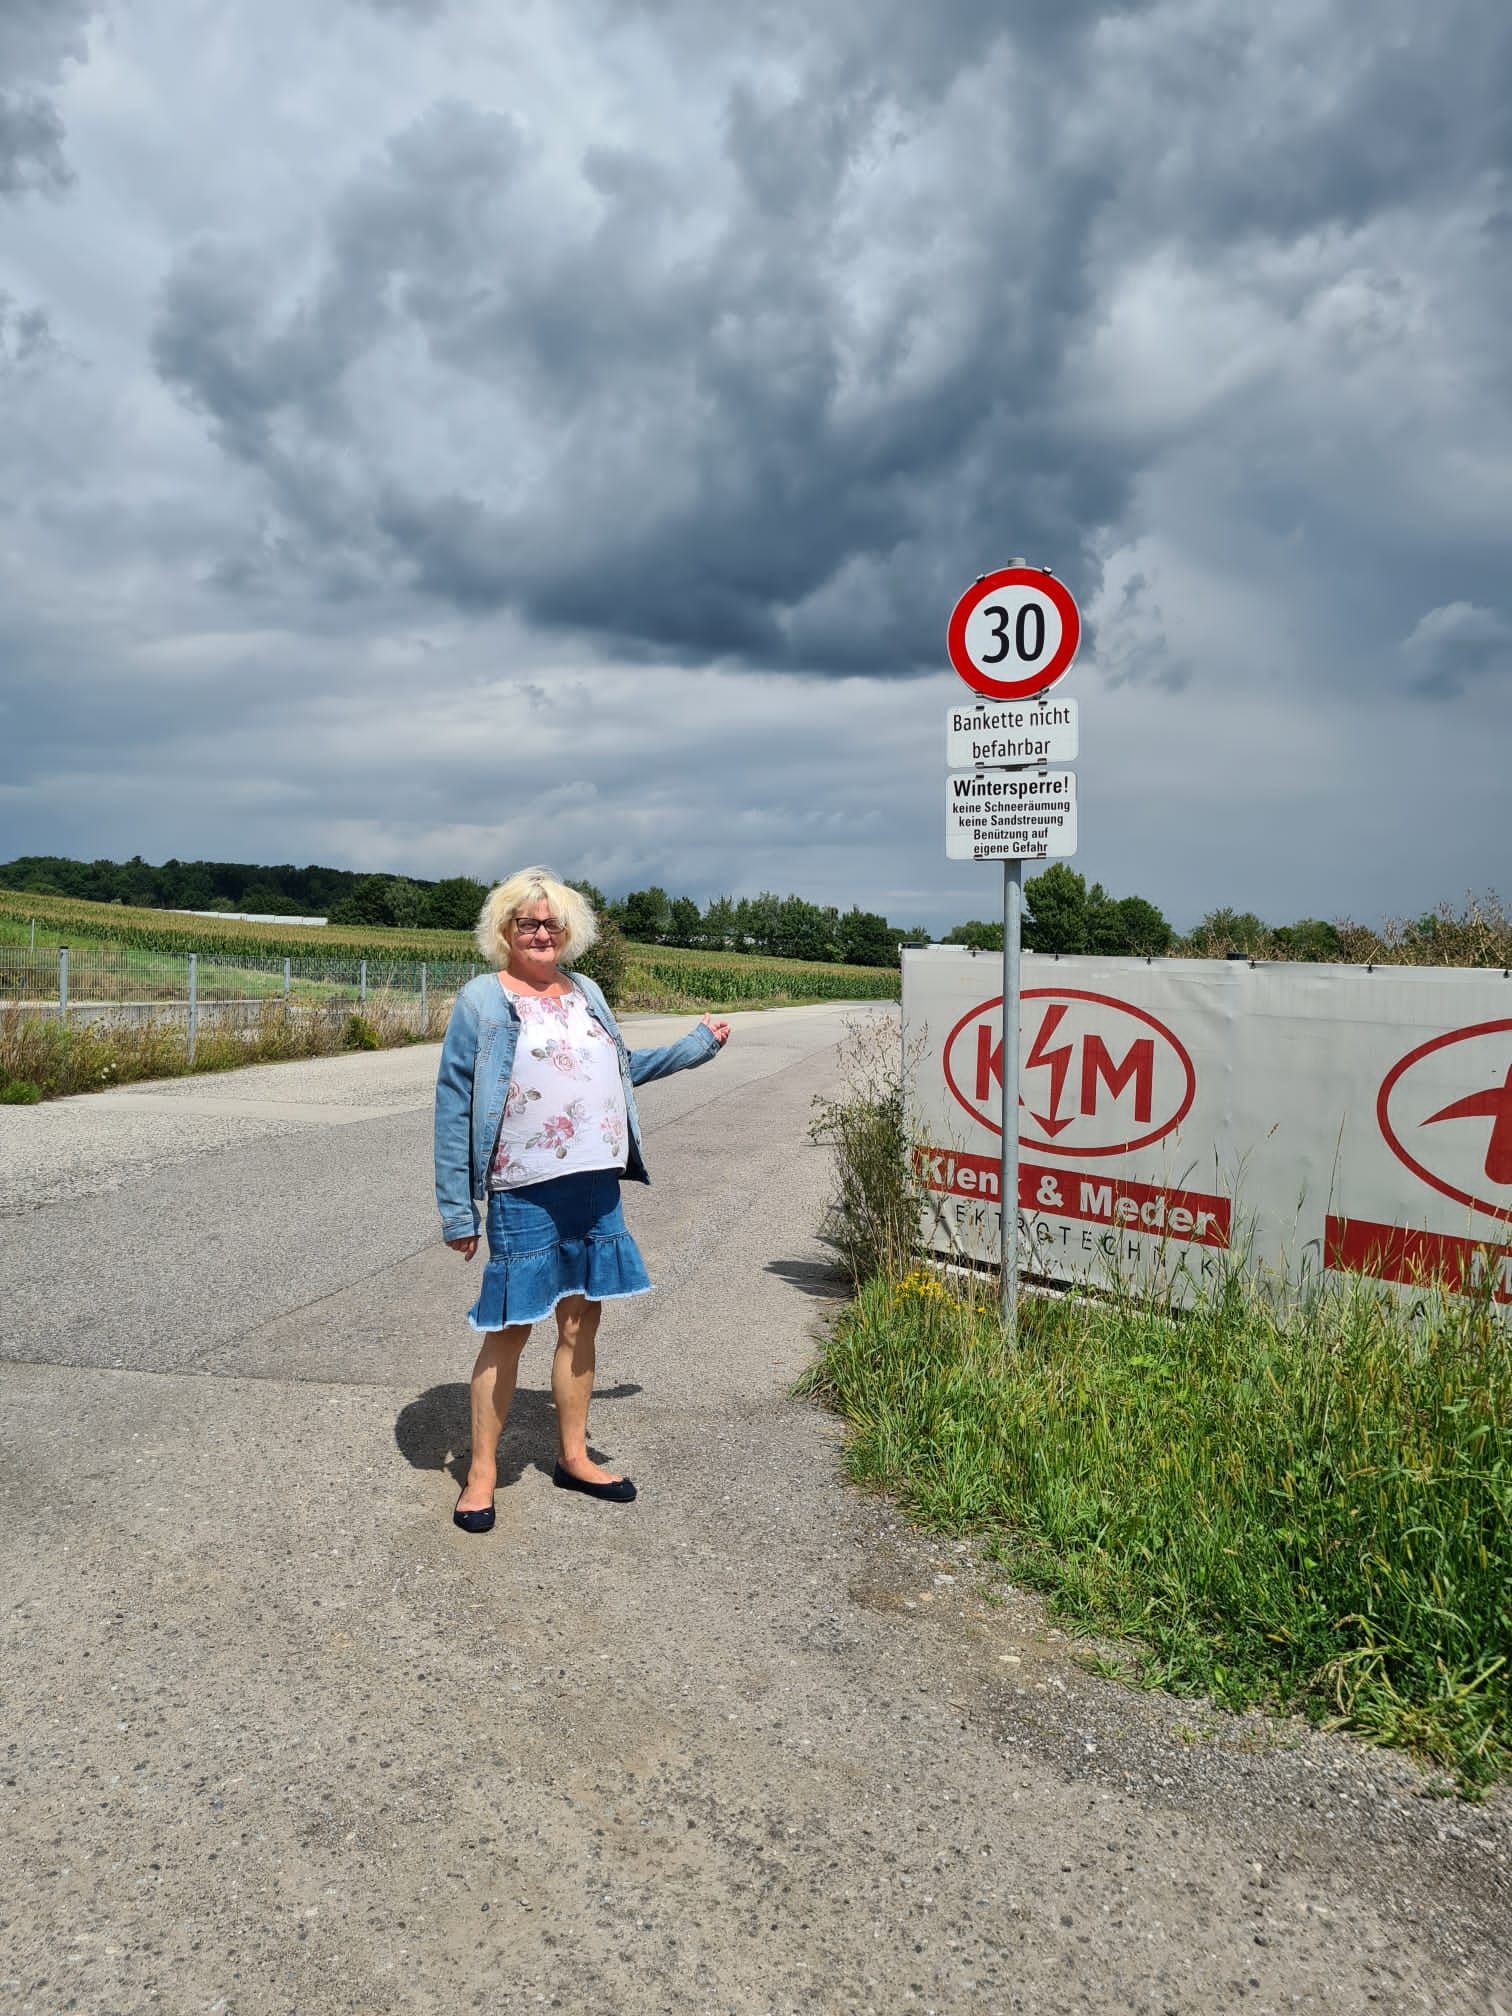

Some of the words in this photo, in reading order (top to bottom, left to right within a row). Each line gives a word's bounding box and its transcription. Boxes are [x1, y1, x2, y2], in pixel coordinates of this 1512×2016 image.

[981, 603, 1045, 664] 30
[953, 712, 1024, 732] Bankette
[1030, 707, 1070, 726] nicht
[973, 739, 1051, 759] befahrbar
[953, 776, 1068, 799] Wintersperre!
[952, 802, 981, 814] keine
[984, 800, 1071, 813] Schneeräumung
[959, 815, 987, 827] keine
[990, 814, 1064, 827] Sandstreuung
[973, 828, 1029, 841] Benützung
[1031, 827, 1049, 839] auf
[974, 843, 1009, 856] eigene
[1012, 841, 1048, 853] Gefahr
[1036, 1175, 1064, 1207] &
[1079, 1182, 1216, 1236] Meder
